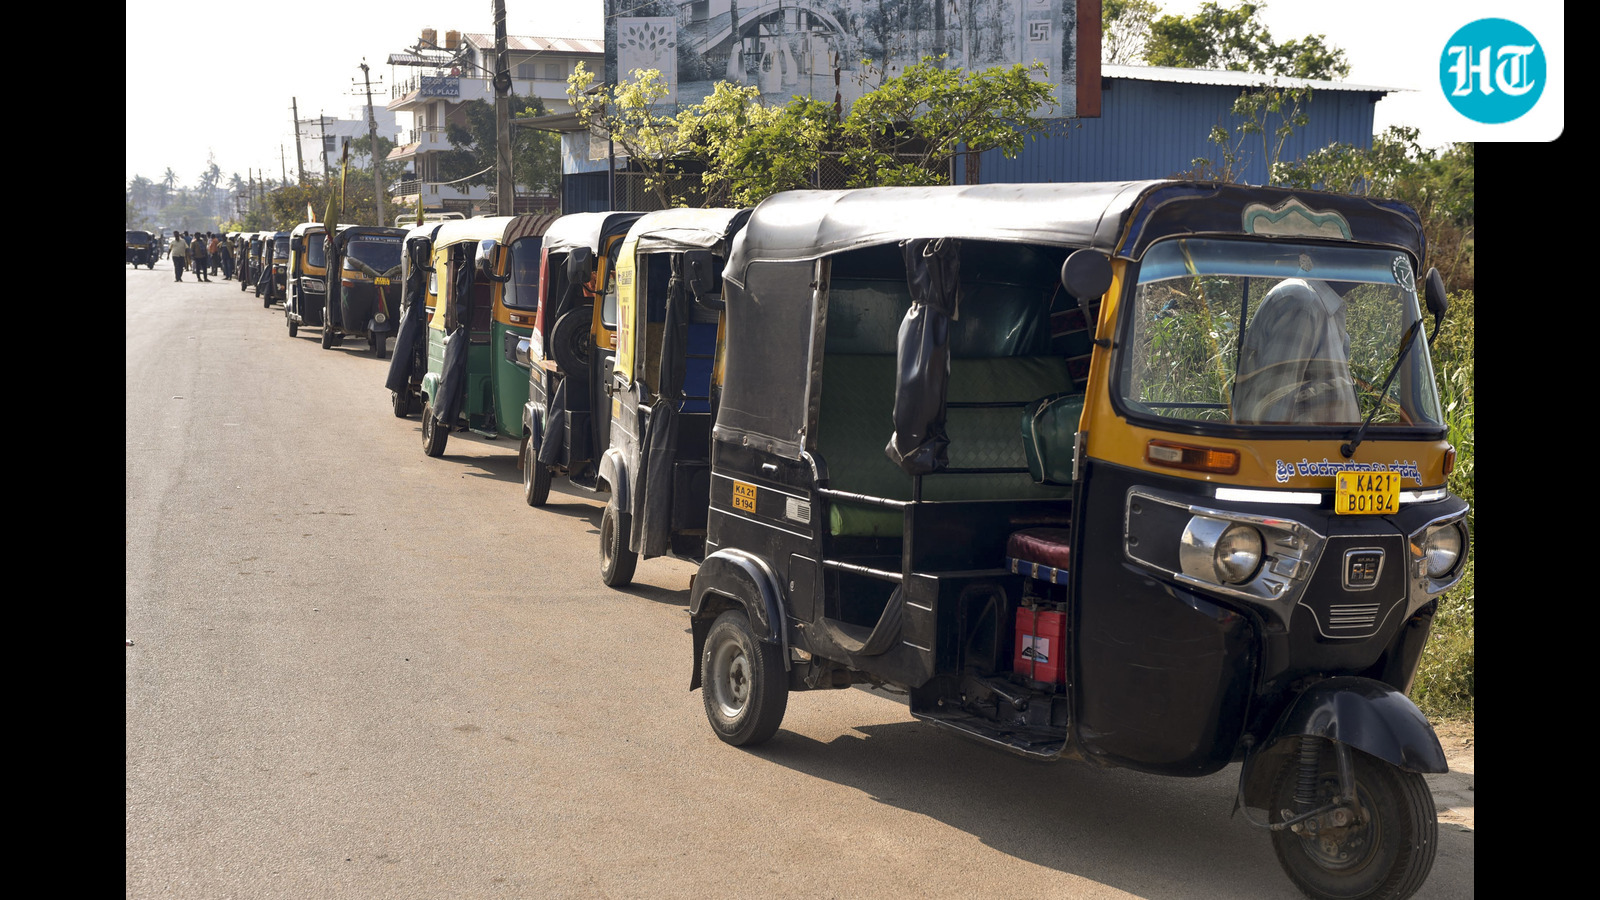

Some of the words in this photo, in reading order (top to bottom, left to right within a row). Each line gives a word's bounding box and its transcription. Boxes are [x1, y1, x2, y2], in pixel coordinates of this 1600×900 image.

[735, 484, 746, 495] KA
[746, 487, 754, 497] 21
[1356, 474, 1391, 492] KA21
[735, 497, 741, 506] B
[741, 498, 753, 510] 194
[1348, 494, 1393, 511] B0194
